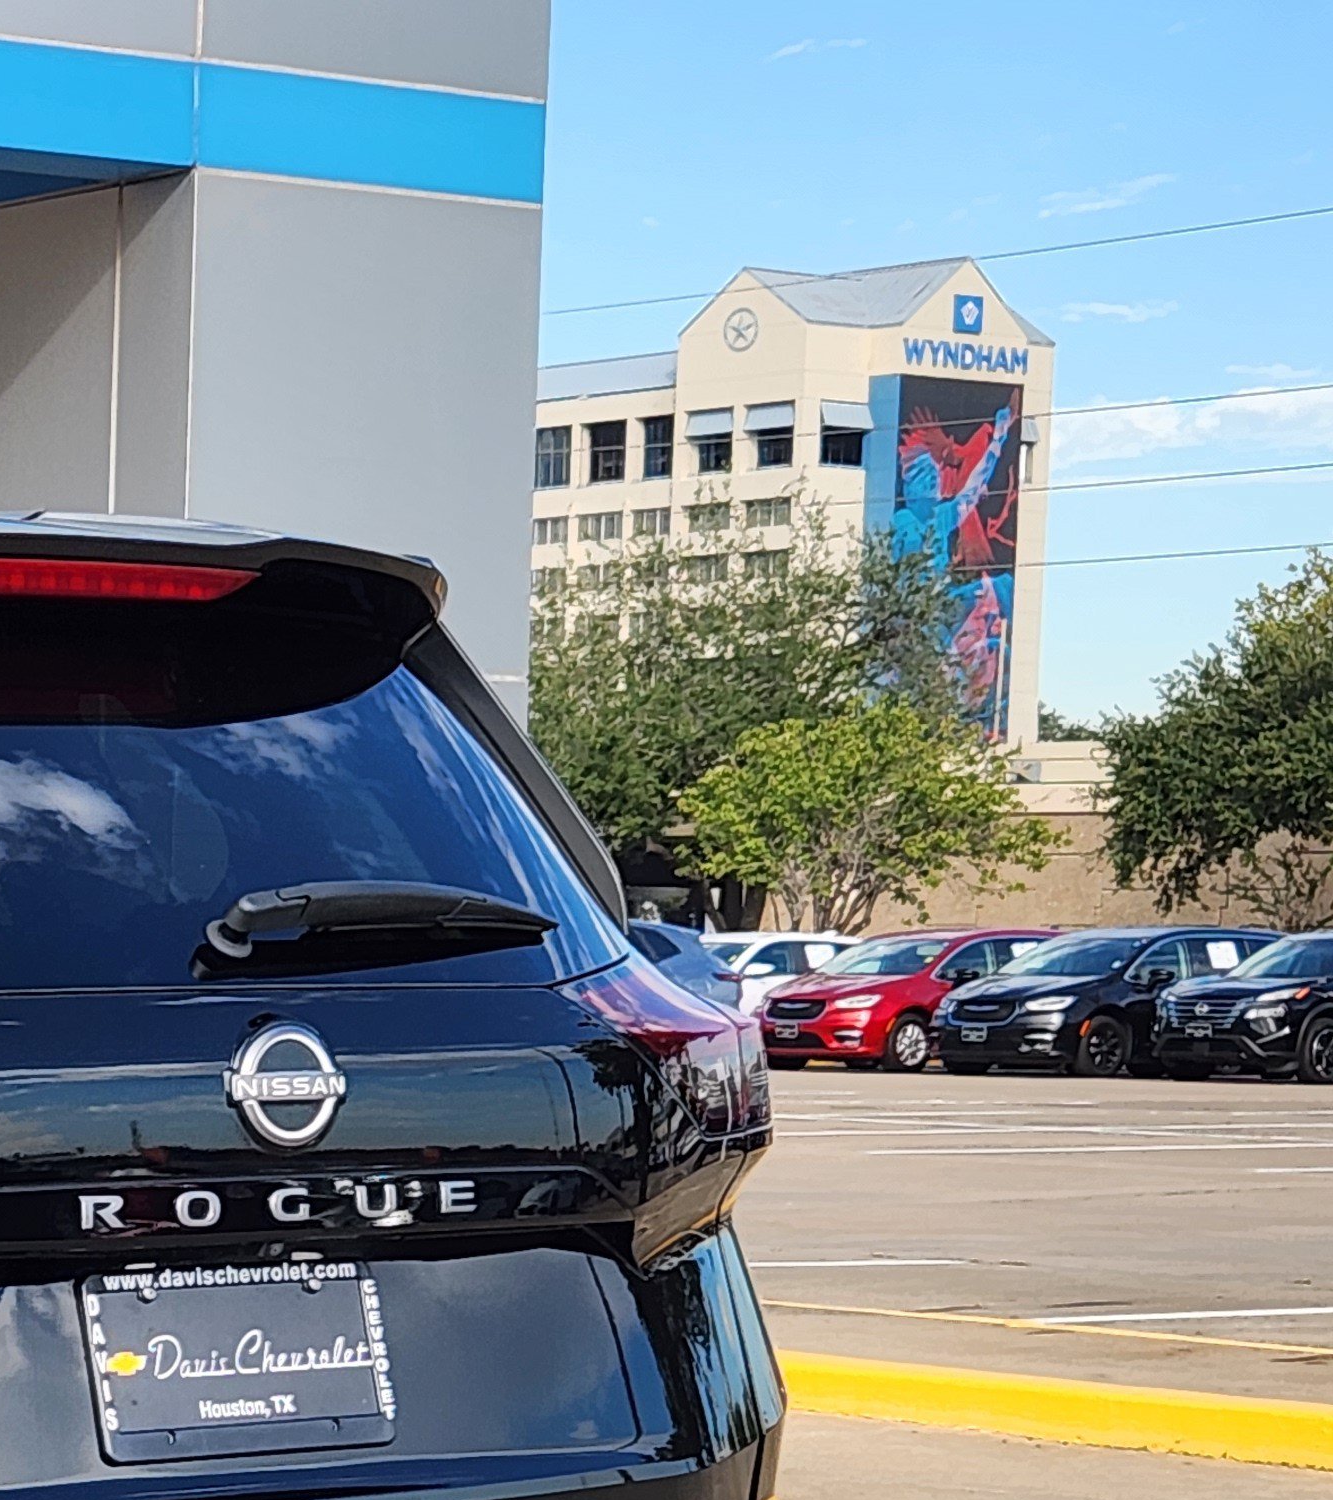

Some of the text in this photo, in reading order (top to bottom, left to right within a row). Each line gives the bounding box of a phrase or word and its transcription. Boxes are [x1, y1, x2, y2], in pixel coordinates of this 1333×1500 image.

[903, 338, 1028, 375] WYNDHAM
[235, 1075, 346, 1097] NISSAN
[79, 1179, 478, 1230] ROGUE
[103, 1262, 357, 1291] www.davischevrolet.com
[86, 1294, 120, 1432] DAVIS
[147, 1329, 375, 1380] Davis Chevrolet
[362, 1279, 397, 1421] CHEVROLET
[199, 1394, 297, 1420] Houston, TX
